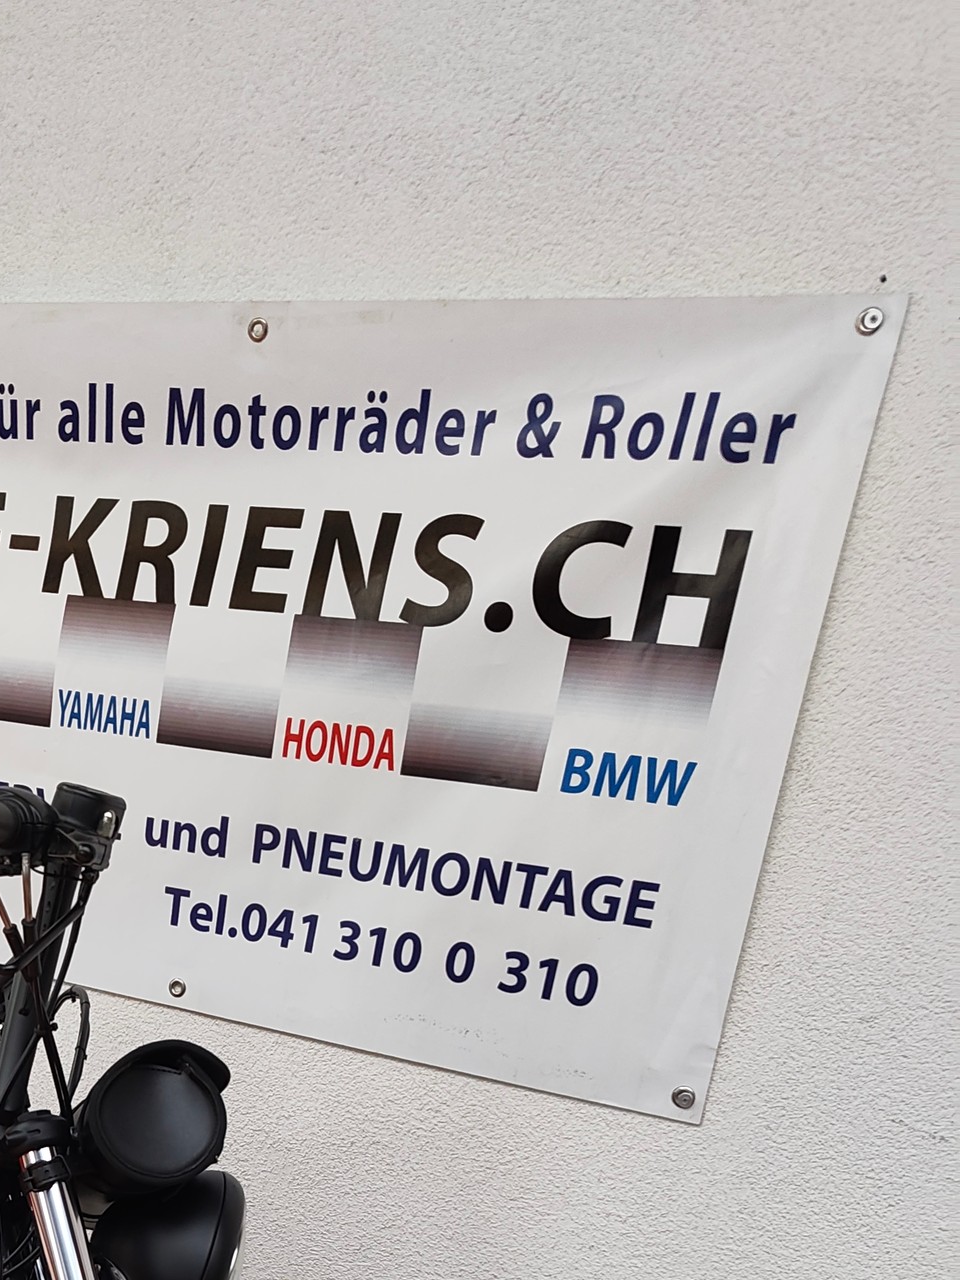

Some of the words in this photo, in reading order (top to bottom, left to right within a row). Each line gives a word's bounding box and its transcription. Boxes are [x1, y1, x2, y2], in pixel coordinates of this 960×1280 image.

[57, 382, 146, 446] alle
[165, 387, 498, 457] Motorräder
[516, 391, 562, 459] &
[581, 390, 797, 465] Roller
[58, 688, 151, 739] YAMAHA
[281, 717, 396, 772] HONDA
[559, 748, 698, 807] BMW
[144, 815, 230, 859] und
[252, 823, 662, 930] PNEUMONTAGE
[164, 885, 320, 954] Tel.041
[332, 920, 422, 973] 310
[445, 941, 476, 984] 0
[497, 950, 599, 1007] 310
